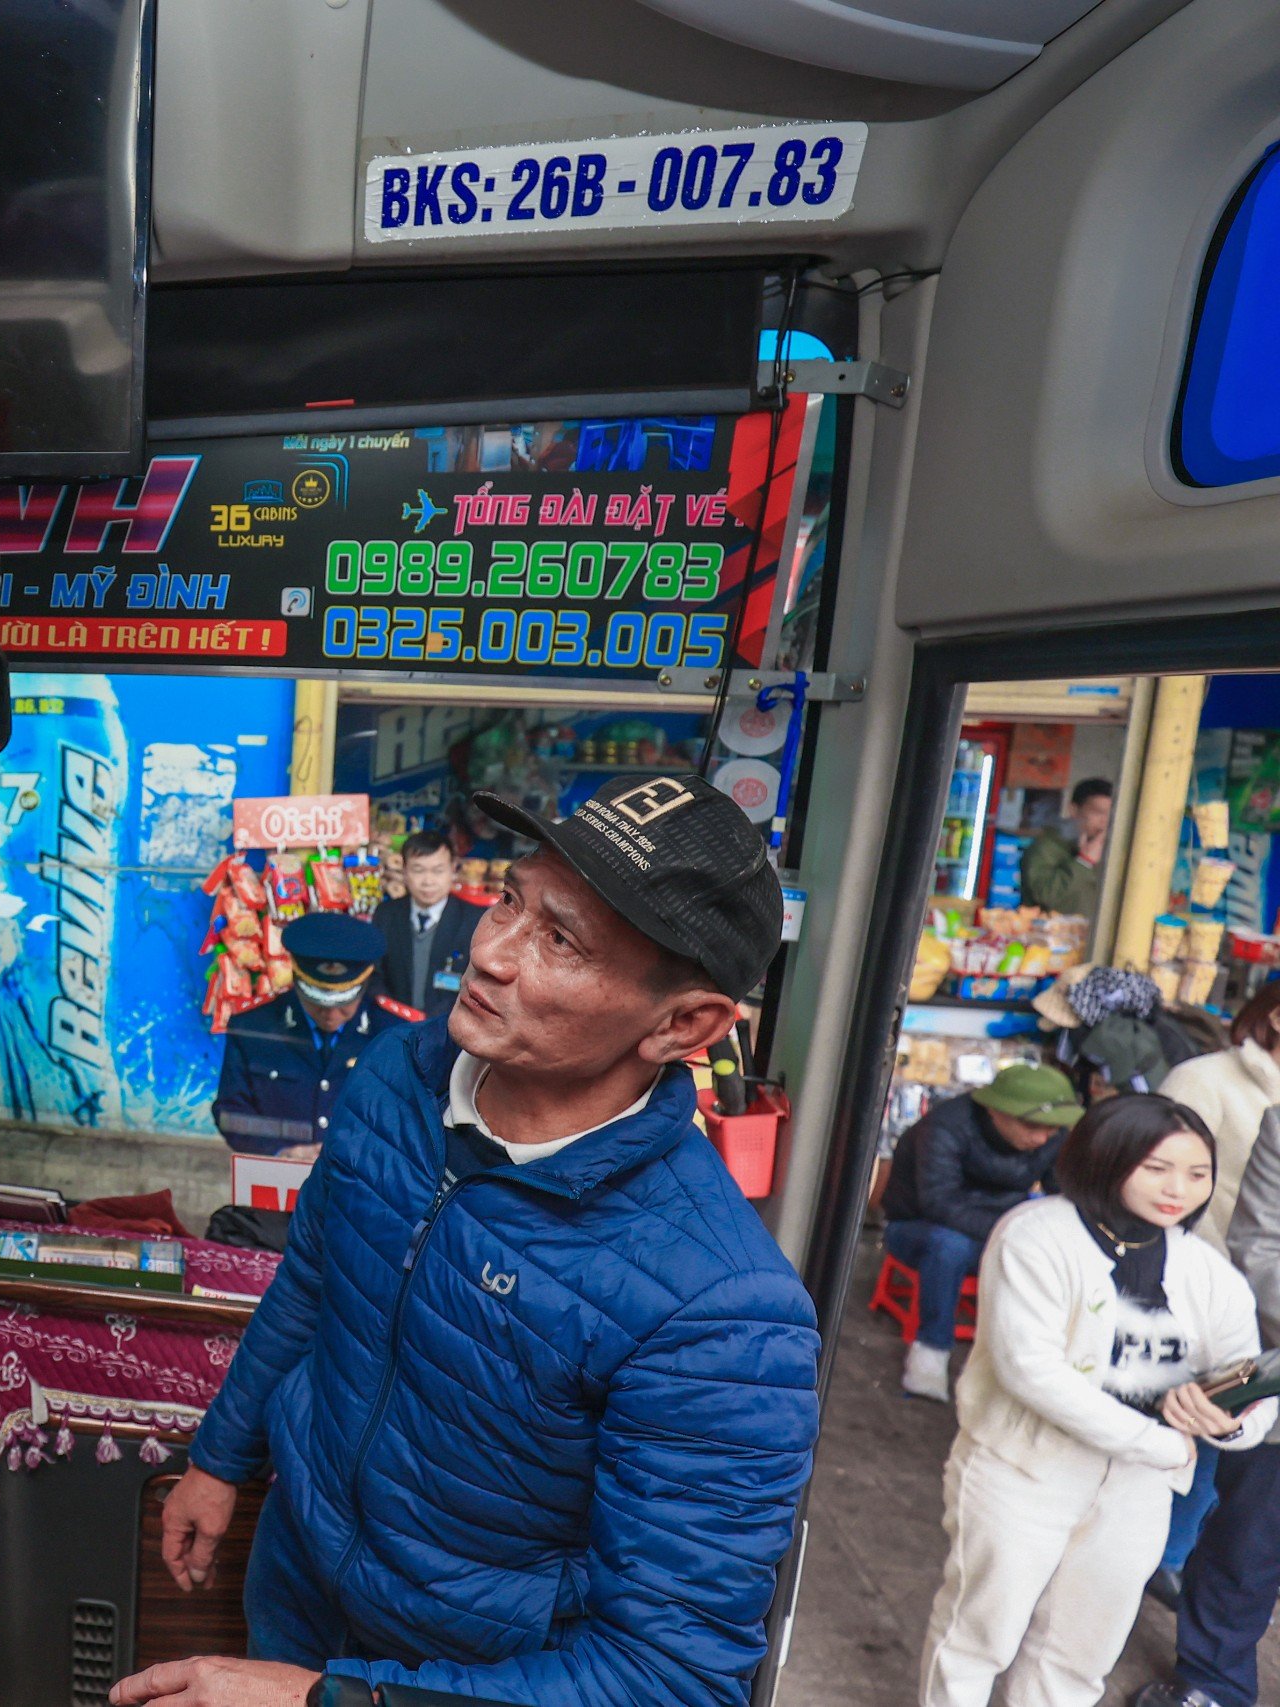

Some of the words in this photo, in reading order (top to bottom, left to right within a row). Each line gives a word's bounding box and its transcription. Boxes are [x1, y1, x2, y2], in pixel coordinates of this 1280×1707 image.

[380, 161, 496, 229] BKS:
[505, 152, 608, 221] 26B
[647, 135, 844, 212] 007.83
[310, 436, 347, 452] ngày
[358, 431, 410, 451] chuyến
[210, 504, 251, 531] 36
[254, 506, 298, 522] CABINS
[453, 481, 531, 537] TỔNG
[539, 487, 597, 526] ĐÀI
[604, 484, 676, 538] ĐẶT
[686, 487, 728, 527] VÉ
[218, 534, 285, 548] LUXURY
[50, 565, 117, 608] MỸ
[126, 563, 231, 610] ĐÌNH
[326, 540, 725, 601] 0989.260783
[48, 621, 88, 647] LÀ
[98, 622, 180, 649] TRÊN
[188, 620, 254, 650] HẾT
[322, 605, 730, 668] 0325.003.005
[261, 805, 344, 843] Oishi
[583, 813, 609, 833] SERIES
[604, 829, 651, 872] CHAMPIONS
